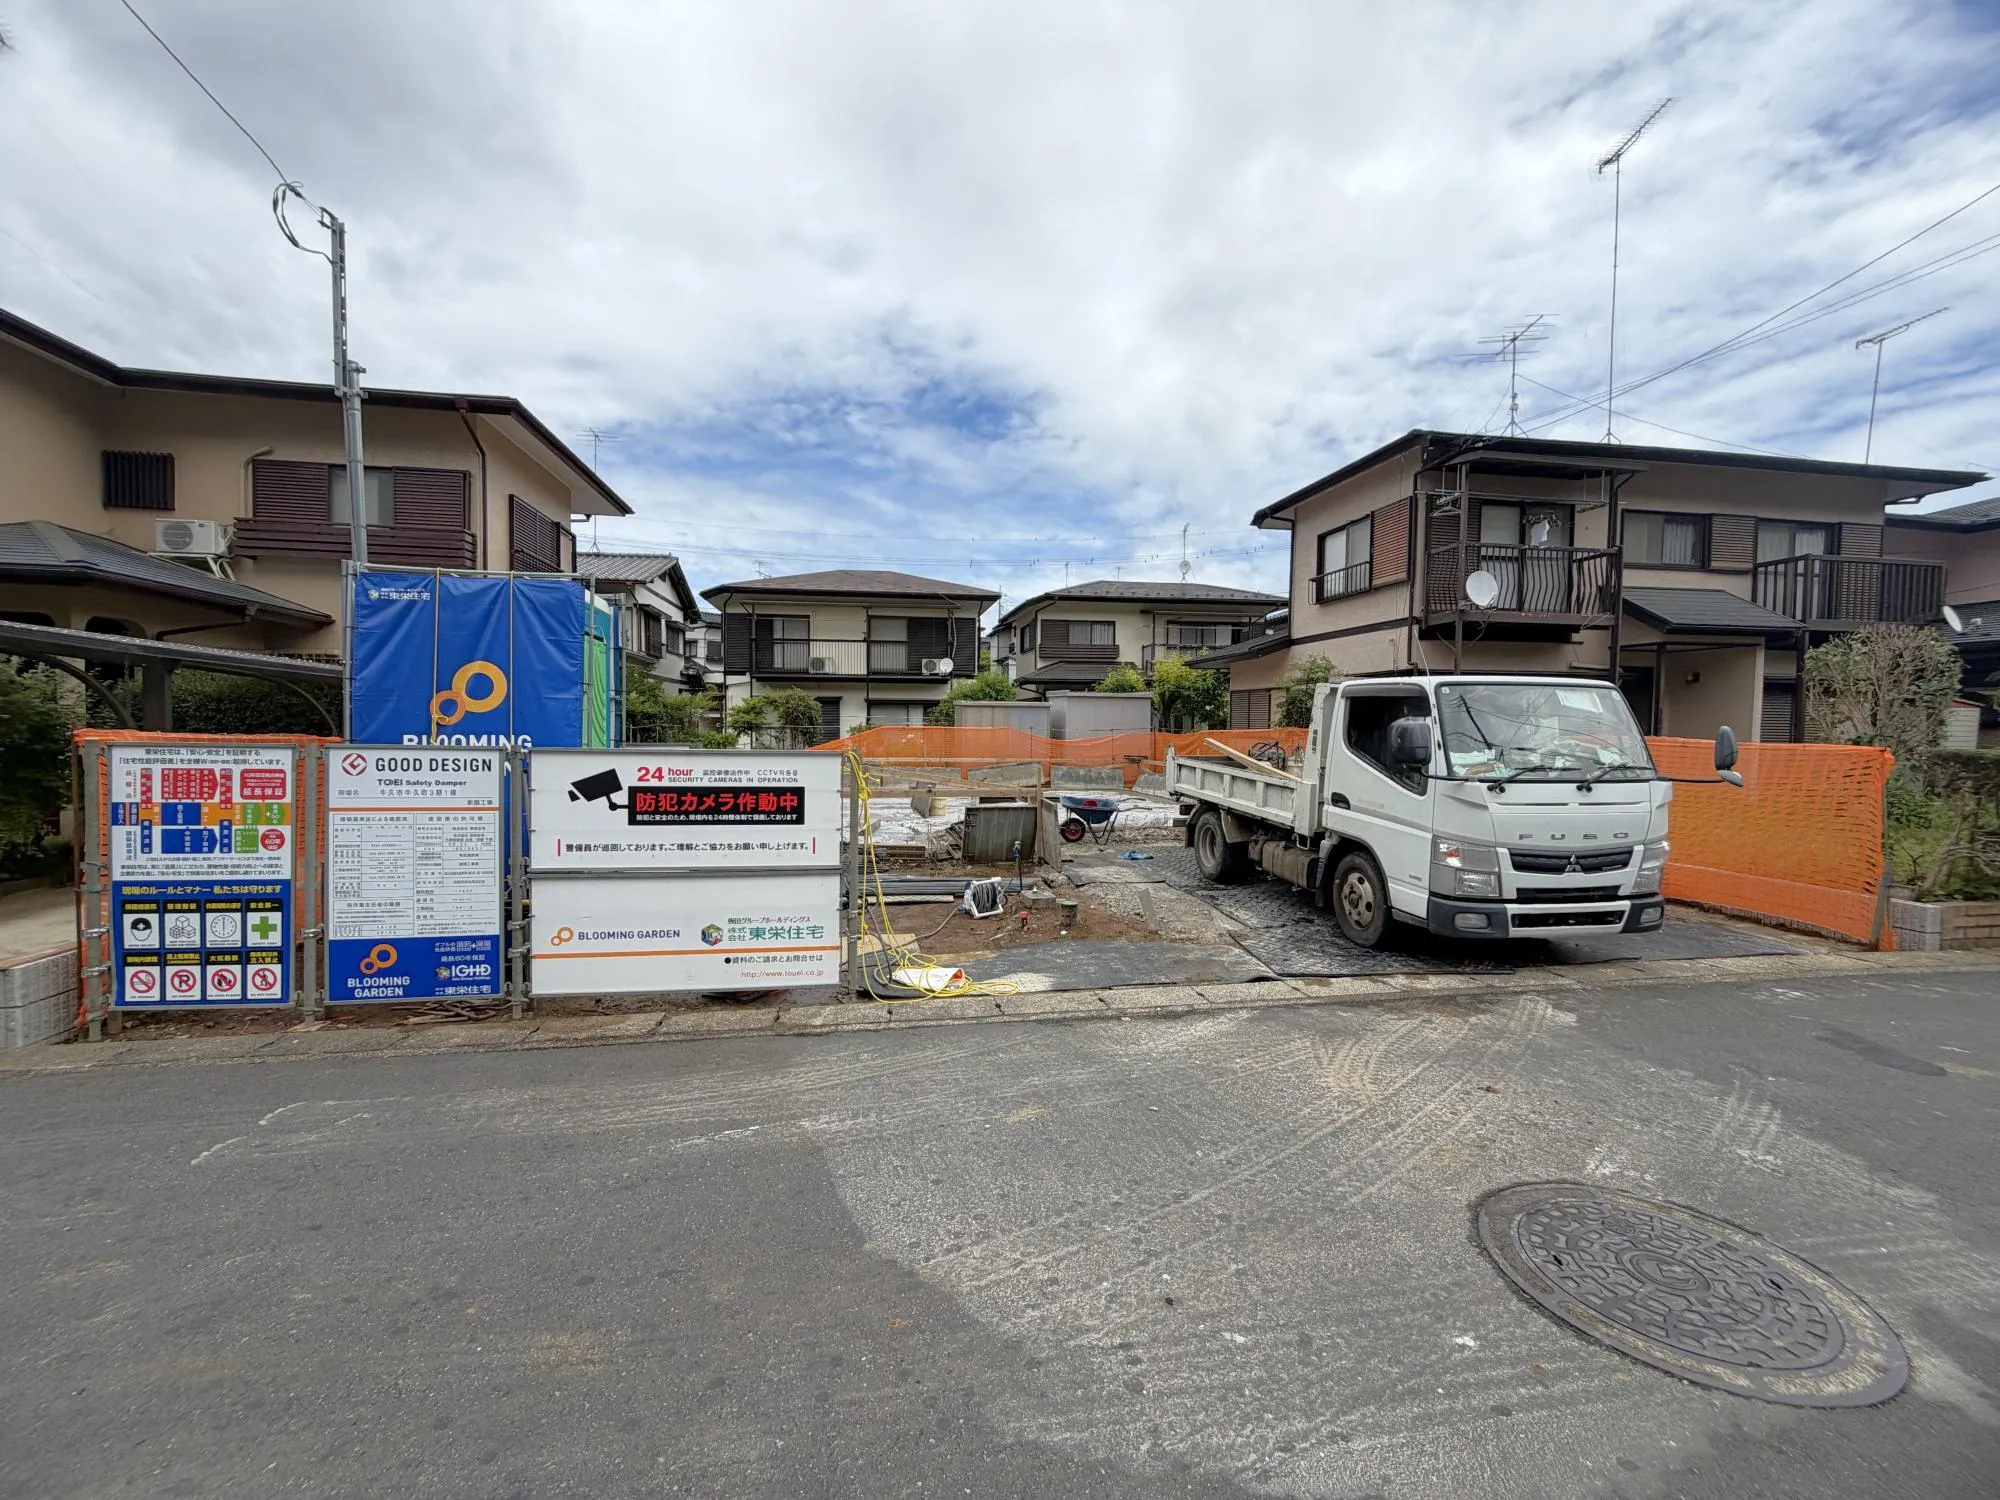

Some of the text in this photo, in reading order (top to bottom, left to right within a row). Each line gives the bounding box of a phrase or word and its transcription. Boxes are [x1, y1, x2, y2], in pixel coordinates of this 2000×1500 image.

[375, 757, 423, 772] GOOD
[429, 757, 493, 772] DESIGN
[636, 766, 694, 783] 24 hour
[405, 779, 433, 788] Safety
[435, 779, 467, 788] Damper
[636, 792, 798, 812] 防犯カメラ作動中
[1518, 832, 1629, 840] FUSO
[121, 885, 283, 895] 現場のルールとマナー 私たちは守ります
[578, 929, 681, 941] BLOOMING GARDEN
[748, 925, 825, 941] 東栄住宅
[451, 964, 492, 977] IGHD
[741, 969, 824, 979] http://www.touei.co.jp
[347, 976, 411, 988] BLOOMING
[354, 987, 404, 998] GARDEN
[444, 985, 492, 995] 東栄住宅
